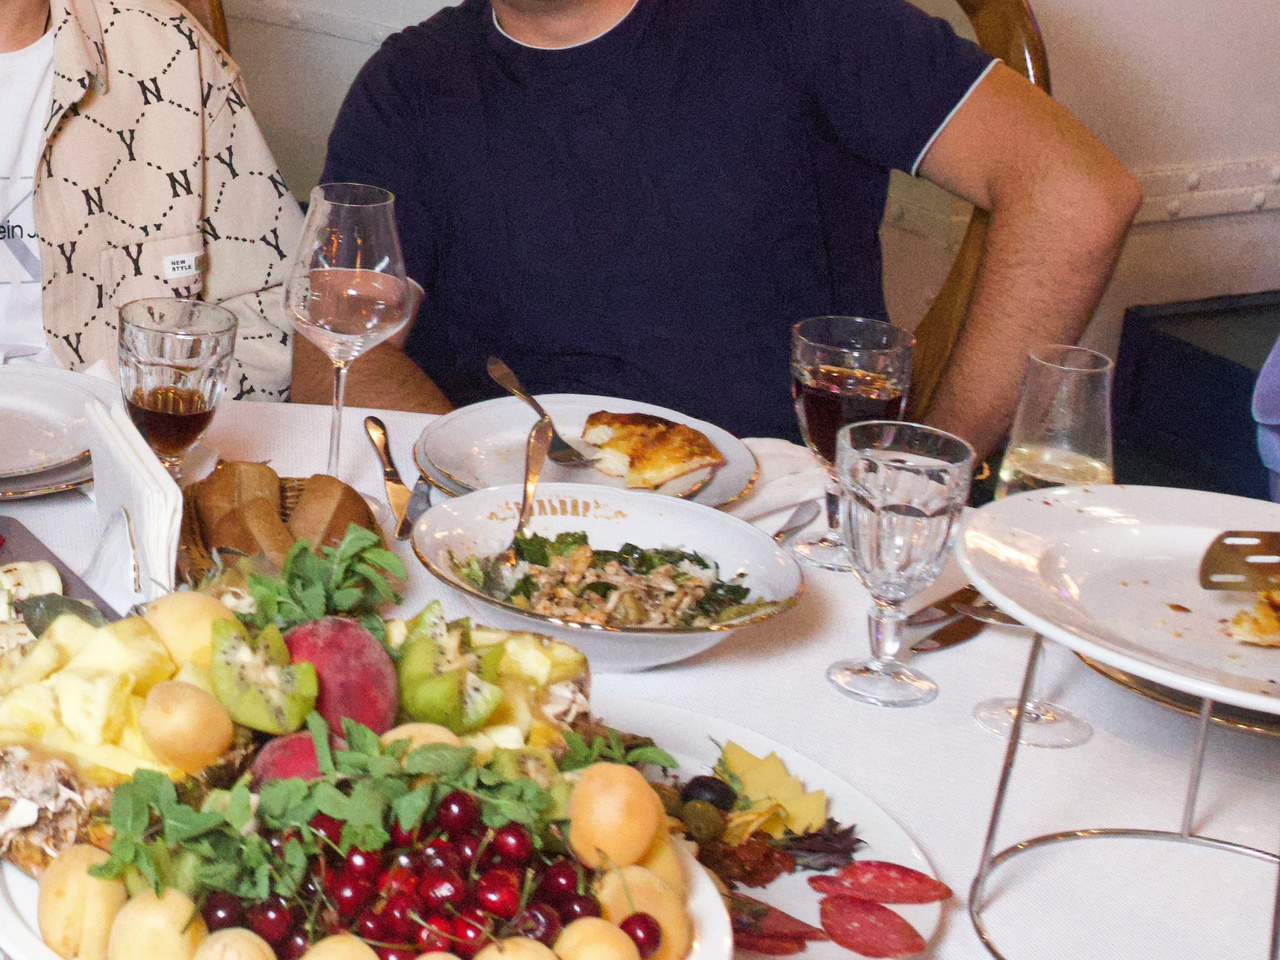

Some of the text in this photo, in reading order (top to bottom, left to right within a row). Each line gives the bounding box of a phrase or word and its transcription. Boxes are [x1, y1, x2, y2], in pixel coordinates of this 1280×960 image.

[137, 77, 164, 105] N
[117, 129, 136, 161] Y
[214, 145, 239, 180] Y
[166, 170, 194, 198] N
[81, 187, 105, 216] N
[58, 241, 77, 274] Y
[123, 243, 143, 276] Y
[260, 227, 287, 260] Y
[514, 498, 591, 518] ЛЬВАР
